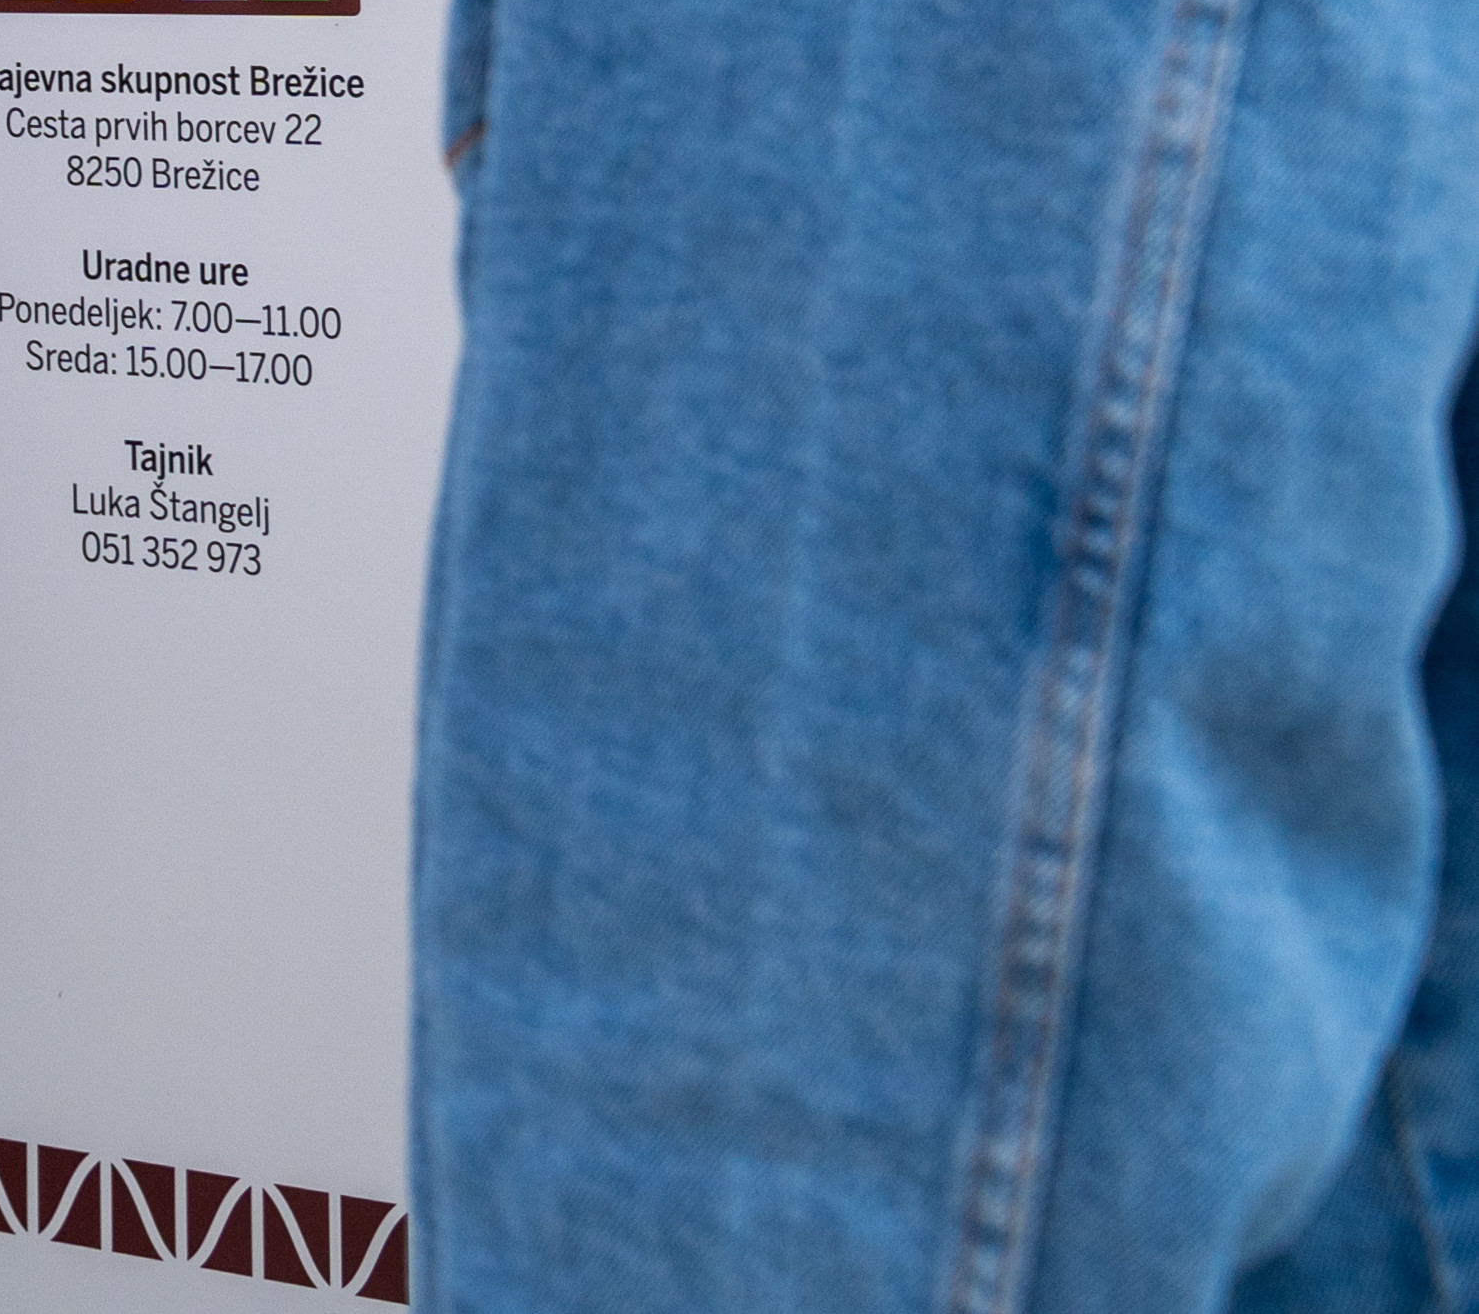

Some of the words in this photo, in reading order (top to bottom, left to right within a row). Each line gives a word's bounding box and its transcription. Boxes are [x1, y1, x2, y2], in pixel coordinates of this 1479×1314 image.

[101, 64, 240, 101] skupnost
[251, 66, 364, 98] Brežice
[7, 107, 85, 139] Cesta
[96, 111, 166, 147] prvih
[178, 112, 275, 143] borcev
[286, 114, 321, 145] 22
[67, 155, 142, 187] 8250
[153, 158, 259, 191] Brežice
[83, 250, 189, 283] Uradne
[200, 263, 248, 286] ure
[0, 292, 161, 335] Ponedeljek:
[26, 340, 116, 374] Sreda:
[125, 440, 213, 480] Tajnik
[73, 484, 140, 518] Luka
[150, 482, 269, 536] Štangelj
[82, 531, 134, 565] 051
[143, 536, 197, 570] 352
[207, 541, 260, 575] 973
